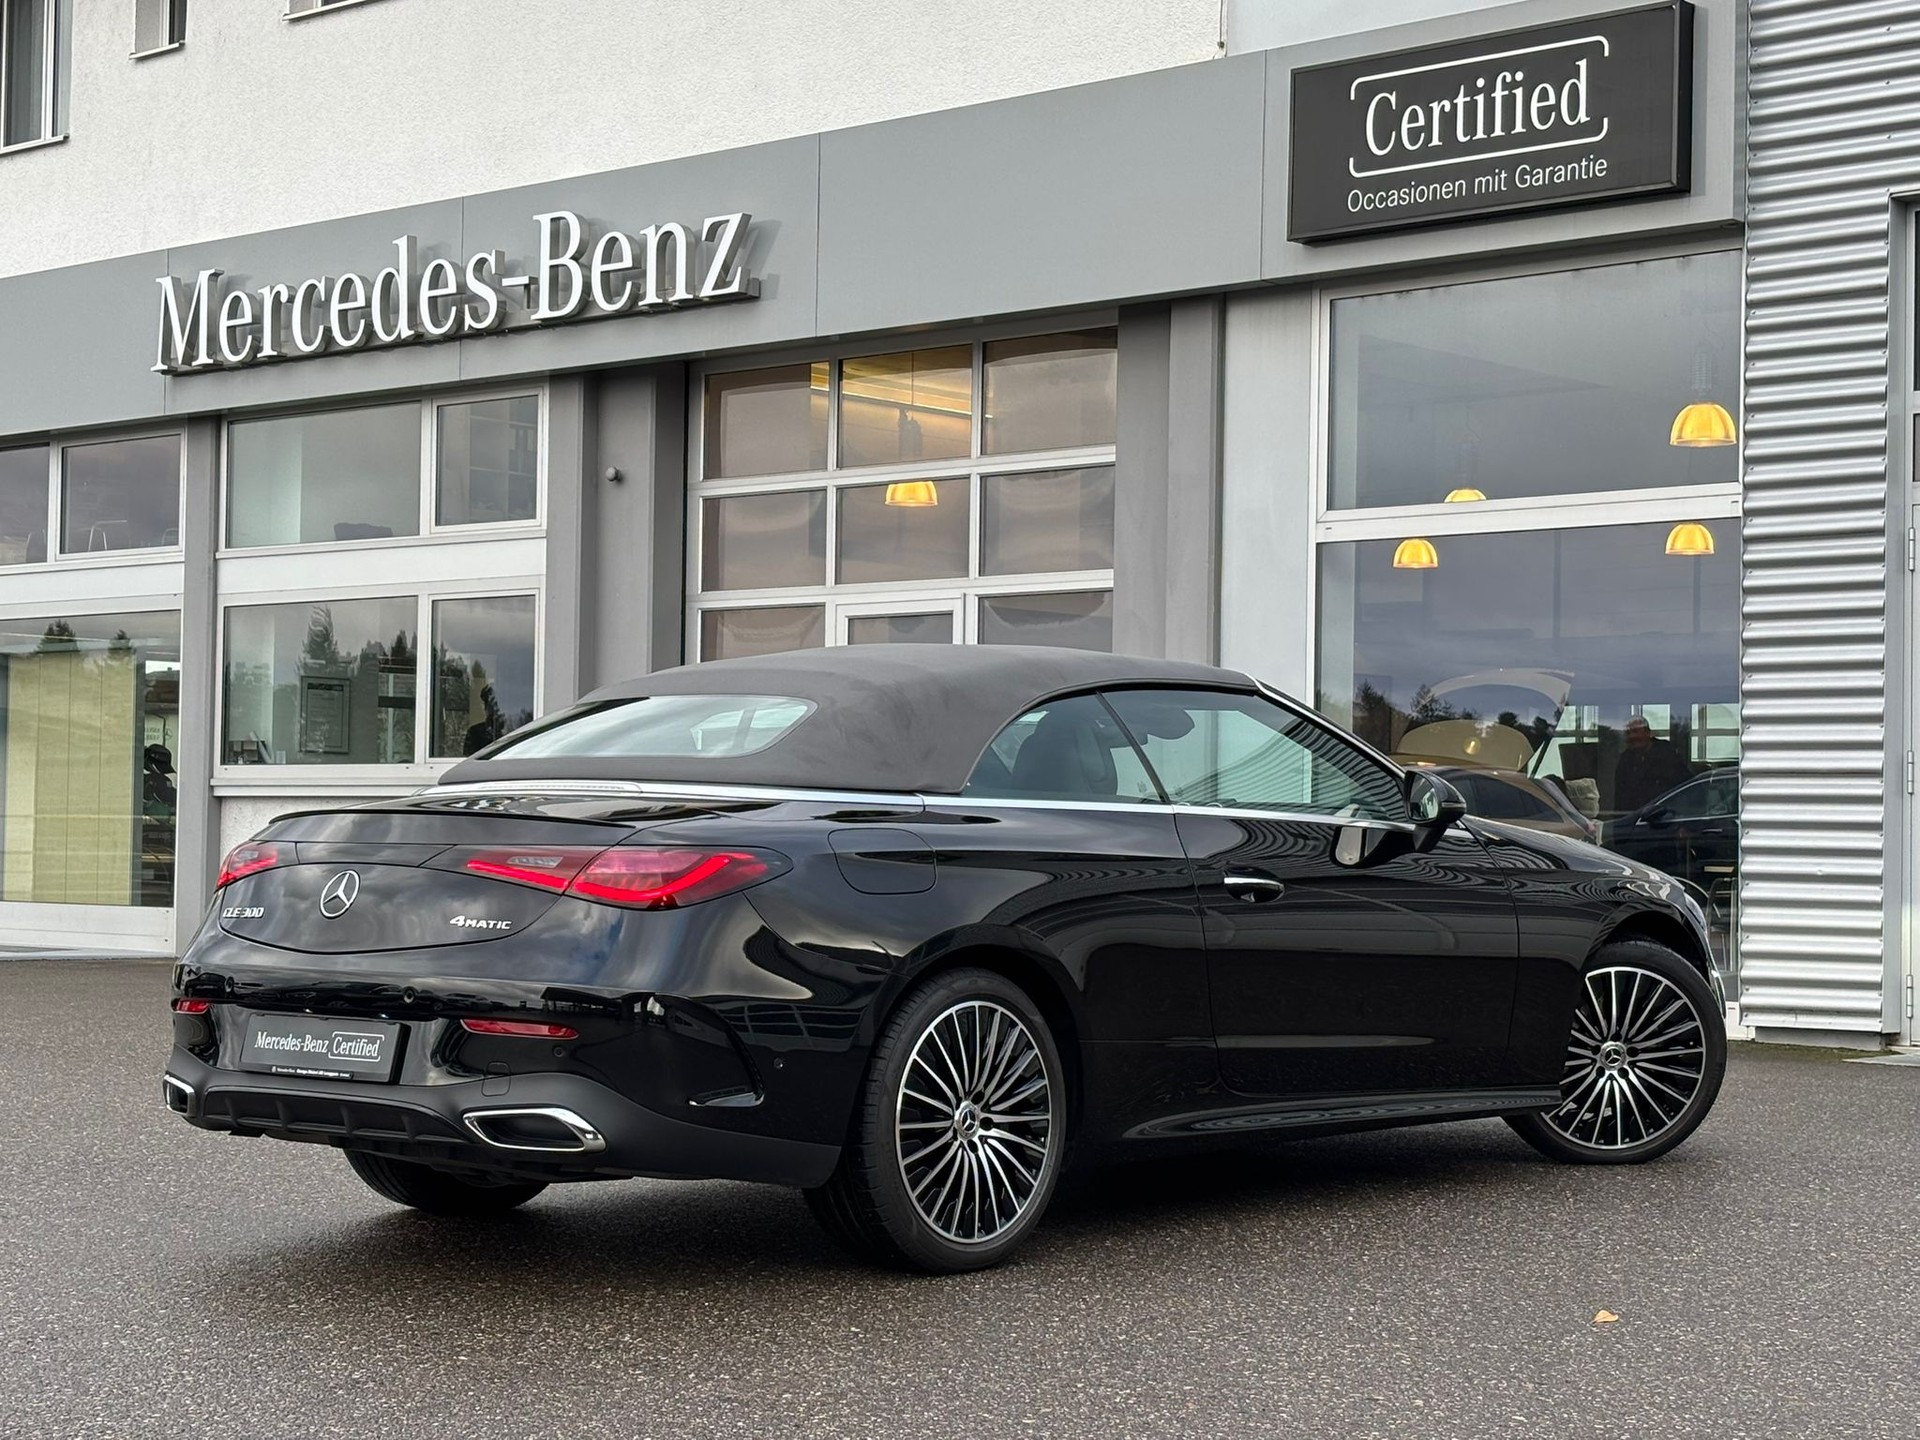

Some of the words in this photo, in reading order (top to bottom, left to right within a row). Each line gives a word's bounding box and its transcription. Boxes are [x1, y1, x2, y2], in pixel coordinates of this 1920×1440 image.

[1365, 57, 1591, 157] Certified
[1347, 176, 1467, 213] Occasionen
[1474, 168, 1508, 195] mit
[1514, 154, 1608, 189] Garantie
[149, 208, 754, 376] Mercedes-Benz
[449, 915, 512, 930] 4MATIC
[254, 1031, 330, 1054] Mercedes-Benz
[332, 1036, 381, 1058] Certified
